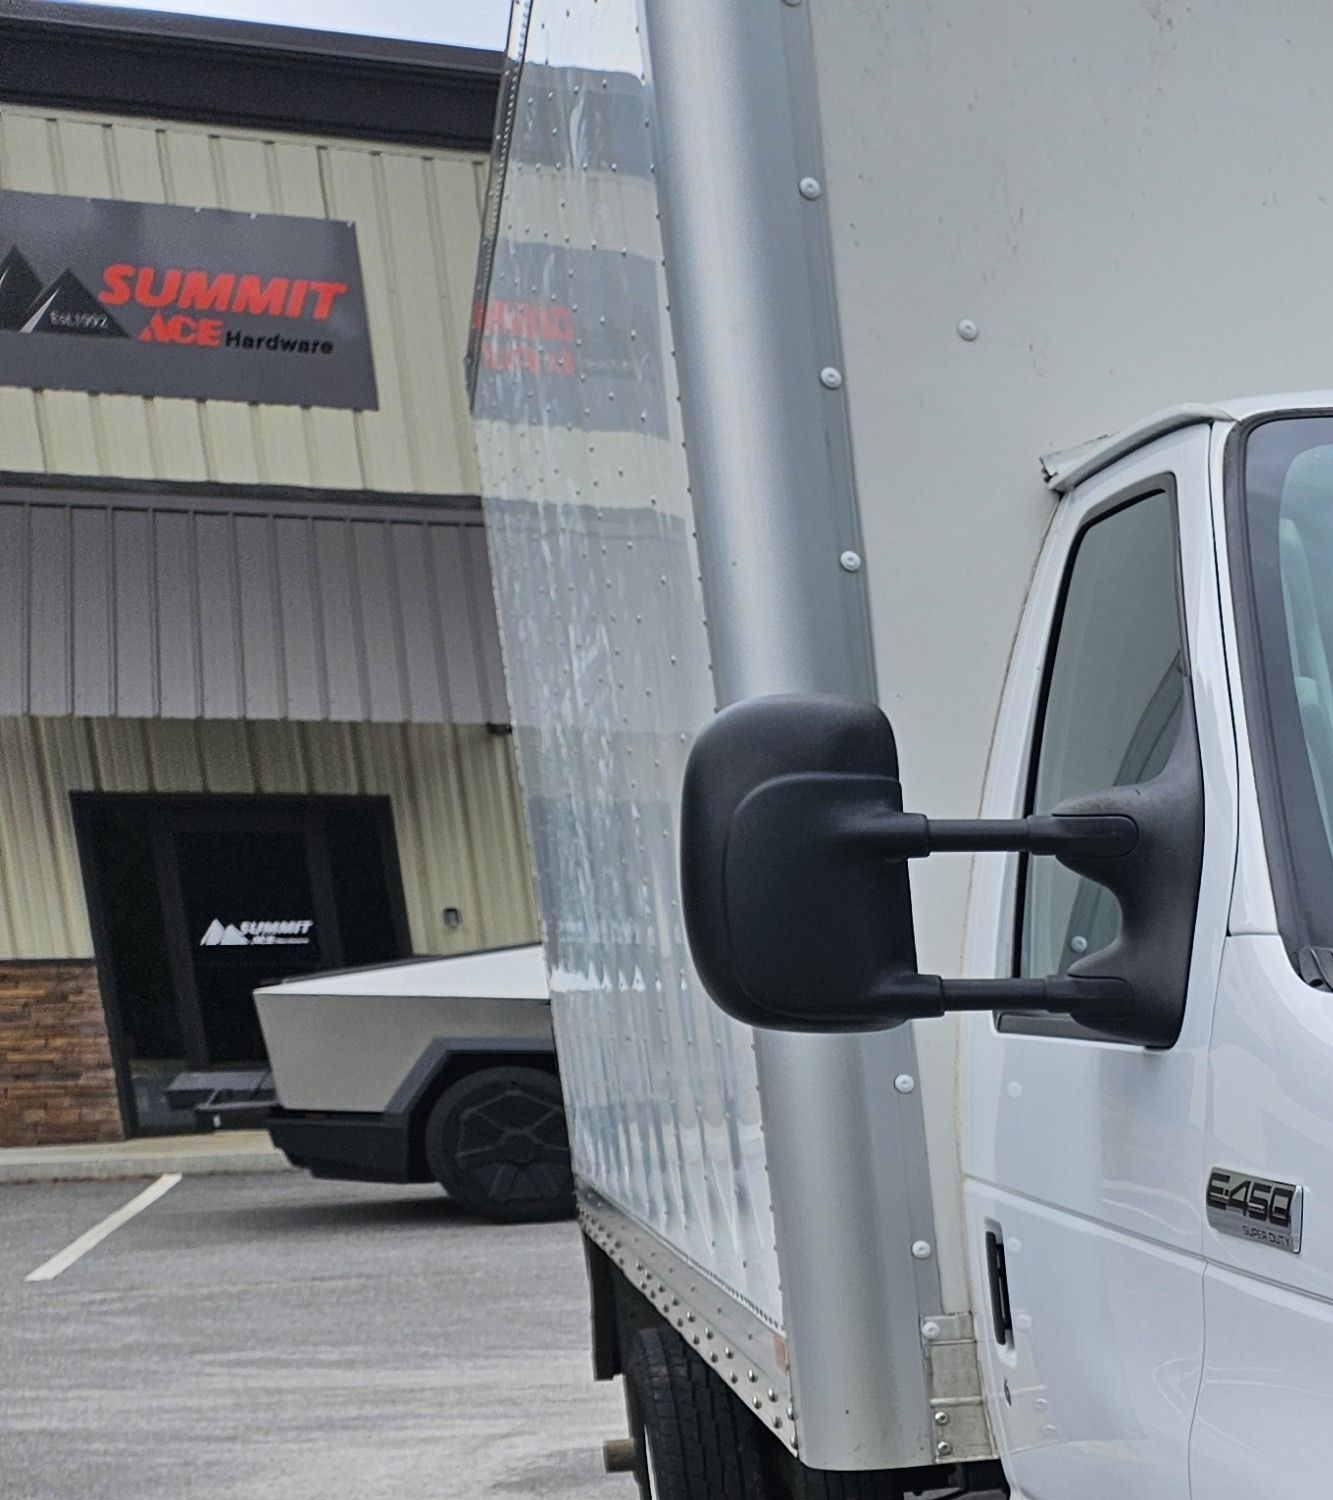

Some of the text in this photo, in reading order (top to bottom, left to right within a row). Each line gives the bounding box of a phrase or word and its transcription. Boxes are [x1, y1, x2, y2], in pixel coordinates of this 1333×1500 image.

[97, 264, 348, 320] SUMMIT
[138, 311, 334, 355] ACE Hardware
[1206, 1172, 1295, 1229] E-450
[1241, 1224, 1291, 1248] SUPER DUTY
